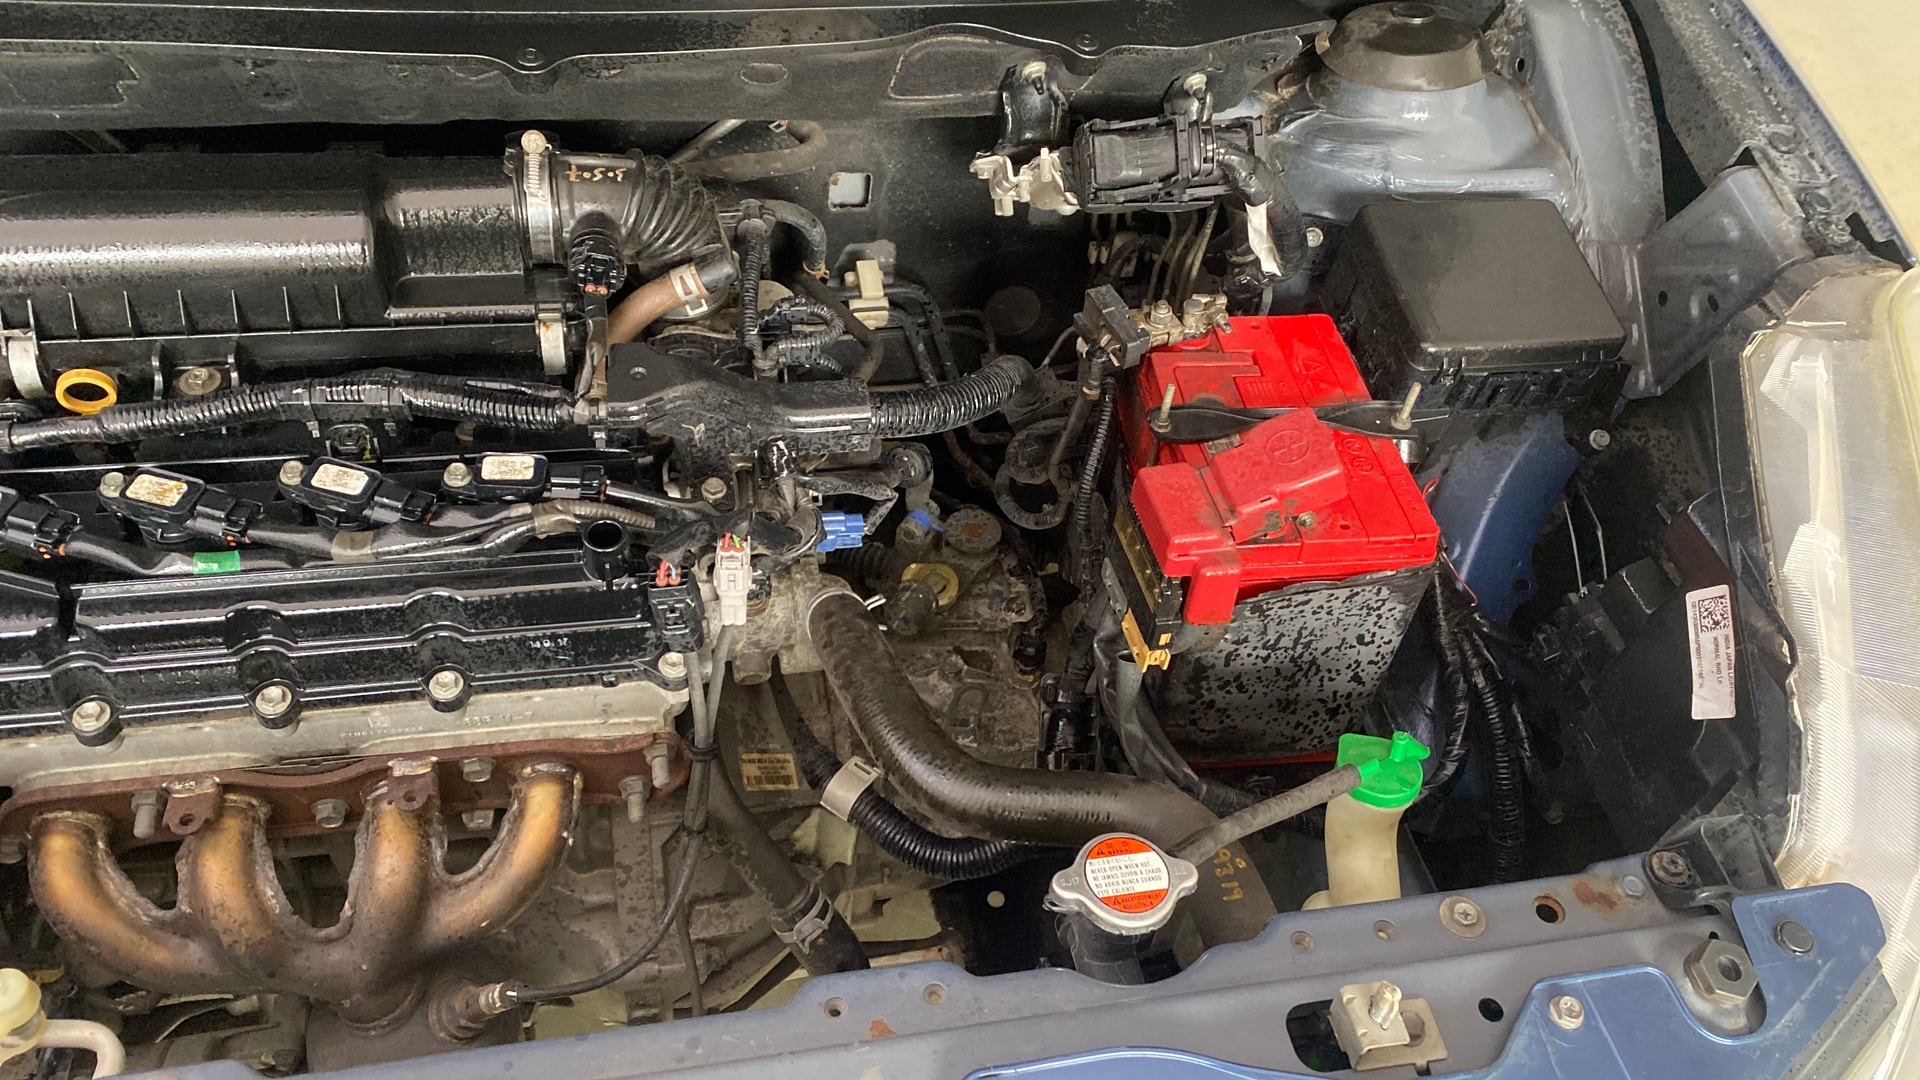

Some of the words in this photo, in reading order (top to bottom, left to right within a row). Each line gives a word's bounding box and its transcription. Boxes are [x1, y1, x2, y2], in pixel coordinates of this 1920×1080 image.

[1713, 636, 1721, 661] NORMAL
[1725, 651, 1733, 671] JAPAN
[1090, 866, 1107, 875] NEVER
[1109, 864, 1123, 873] OPEN
[1124, 862, 1139, 870] WHEN
[1101, 873, 1119, 881] JAMAIS
[1119, 870, 1138, 878] OUVRIR
[1121, 877, 1140, 886] NUNCA
[1140, 875, 1162, 884] CUANDO
